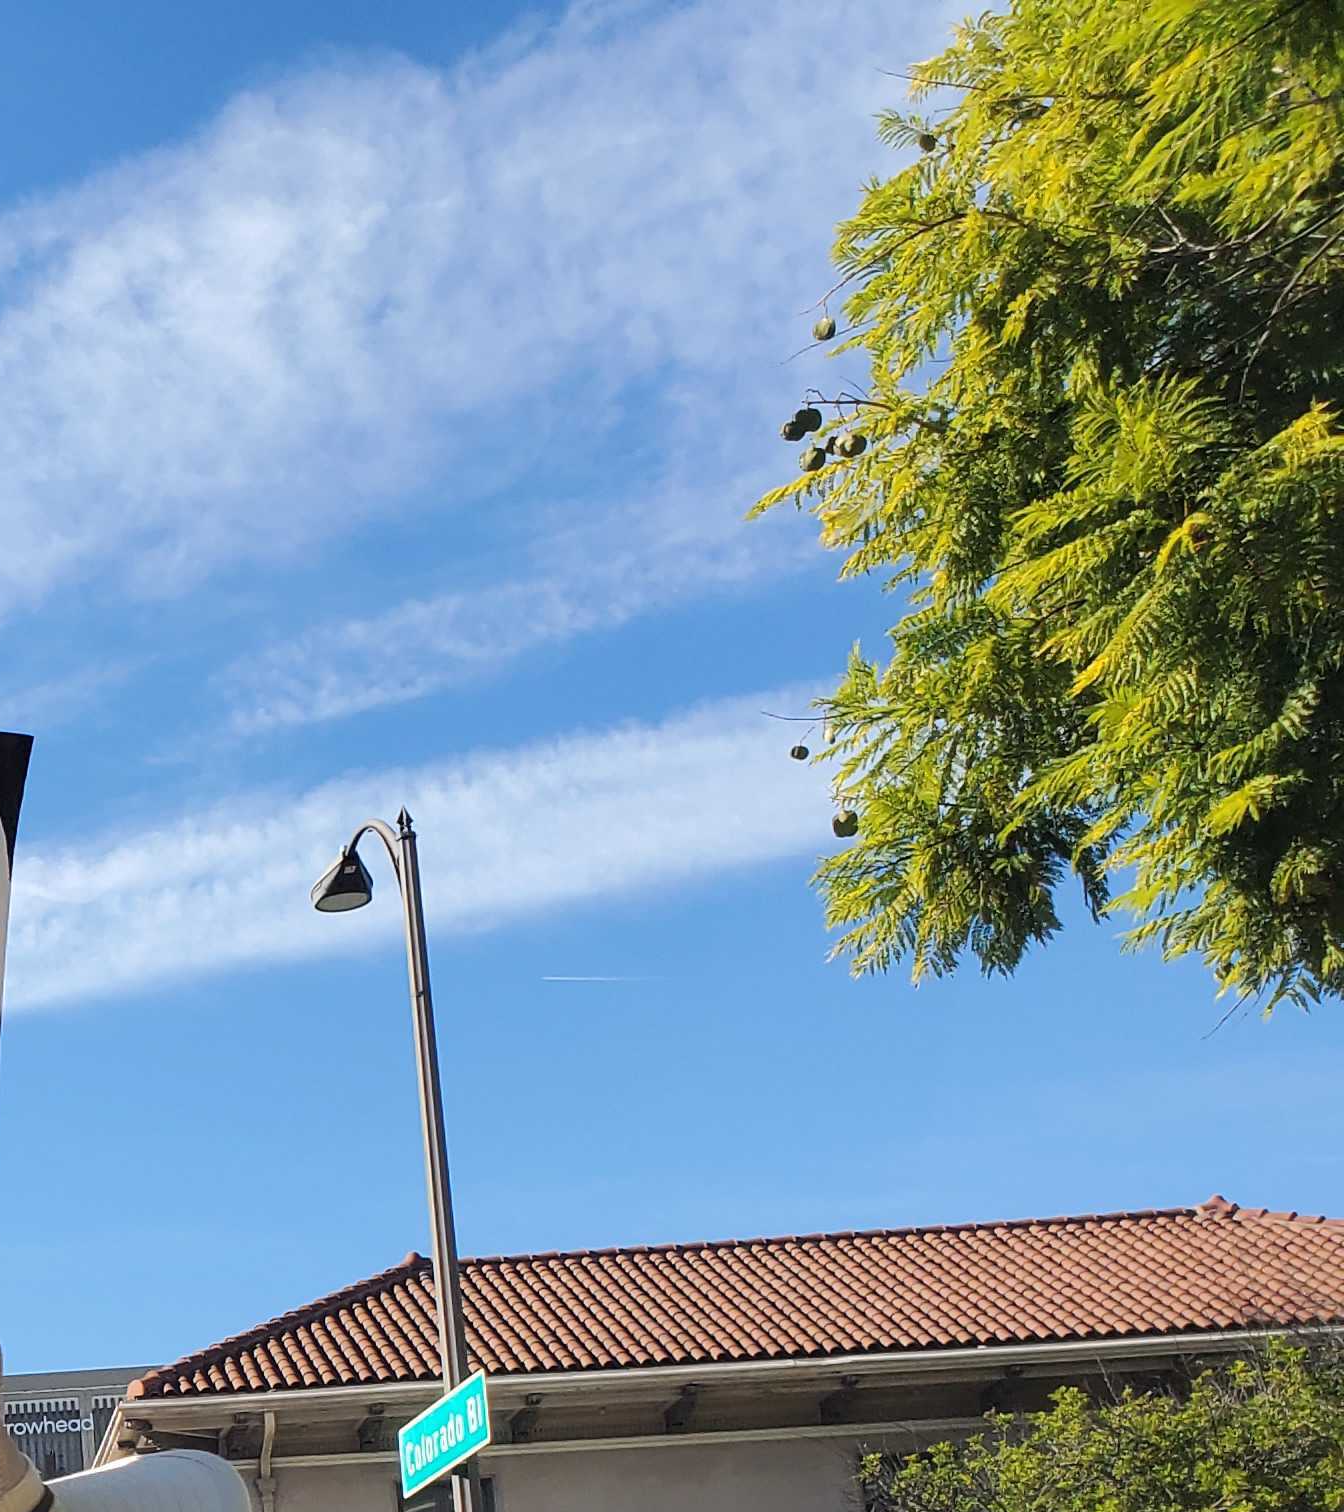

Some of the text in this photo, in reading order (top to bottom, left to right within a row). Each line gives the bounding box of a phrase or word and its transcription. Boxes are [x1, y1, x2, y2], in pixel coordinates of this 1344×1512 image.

[5, 1412, 94, 1436] rowhead
[405, 1393, 483, 1477] Colorado Bl
